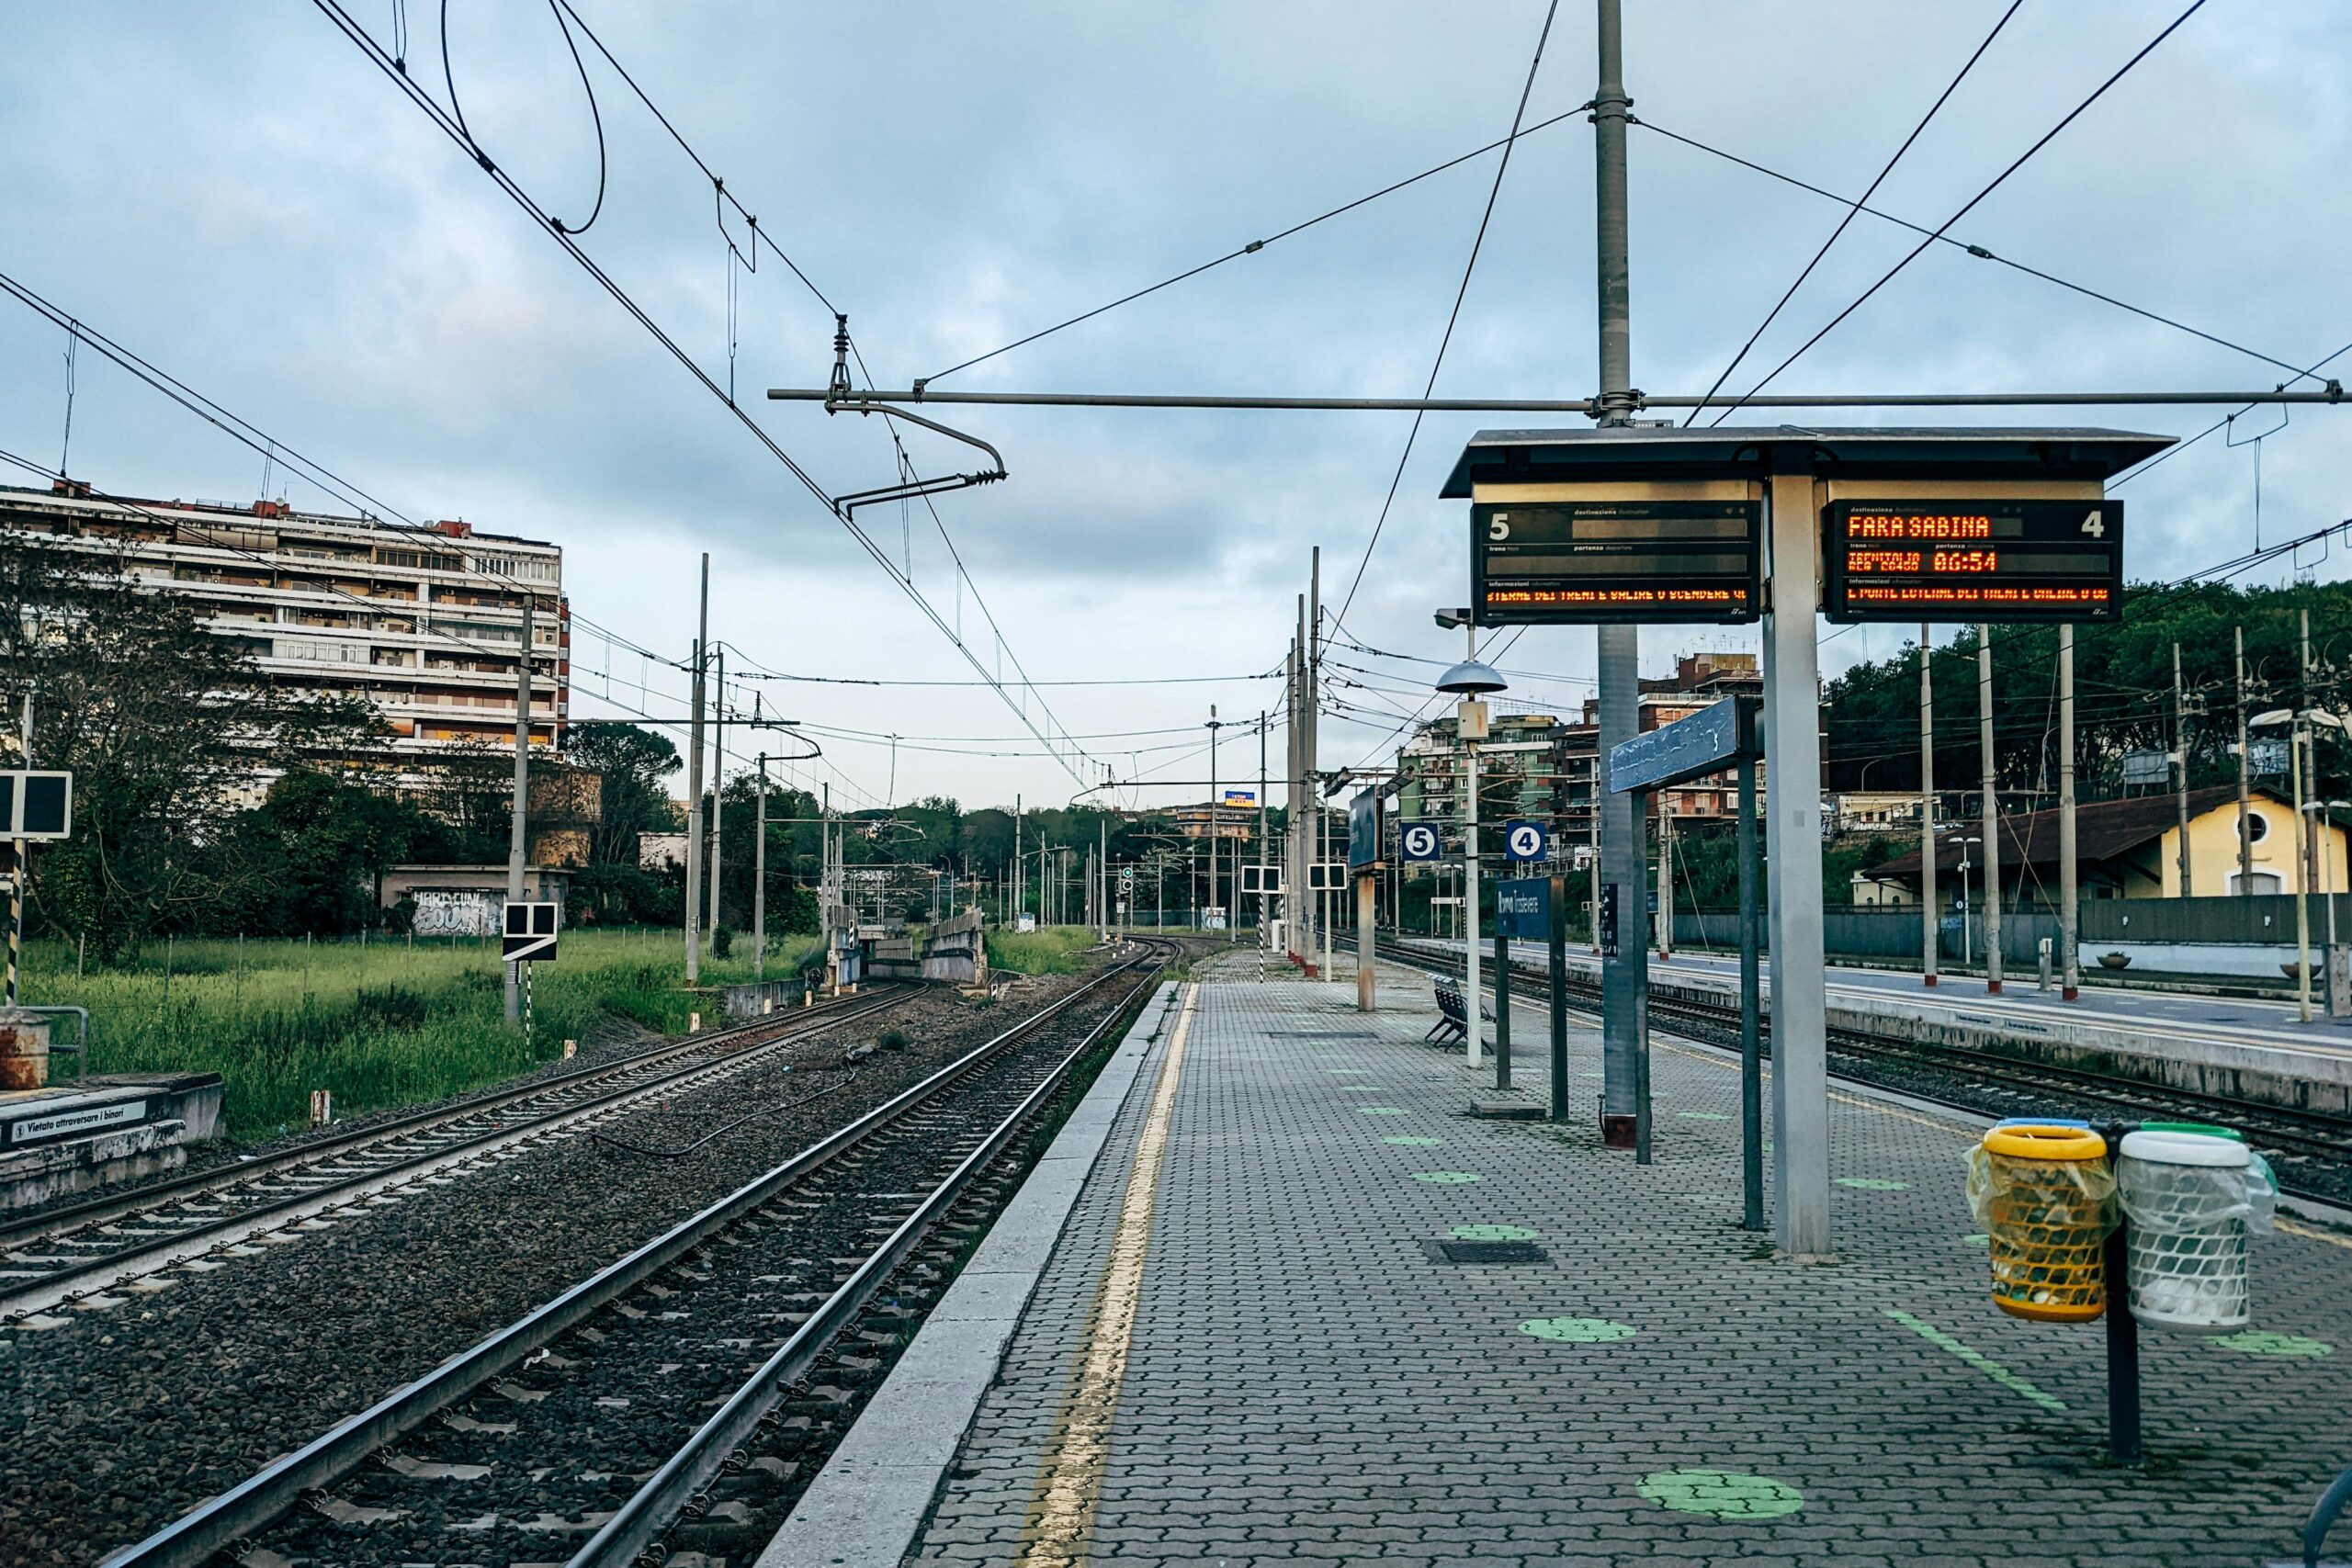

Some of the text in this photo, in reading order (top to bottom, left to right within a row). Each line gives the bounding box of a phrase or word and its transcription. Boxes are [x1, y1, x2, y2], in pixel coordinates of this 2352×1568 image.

[1488, 513, 1510, 541] 5
[1849, 515, 1989, 537] FARA SABINA
[2081, 510, 2105, 538] 4
[1934, 552, 1996, 571] 06:54
[1412, 830, 1429, 853] 5
[1517, 831, 1533, 851] 4
[27, 1107, 124, 1134] Vietato attraversare i binari
